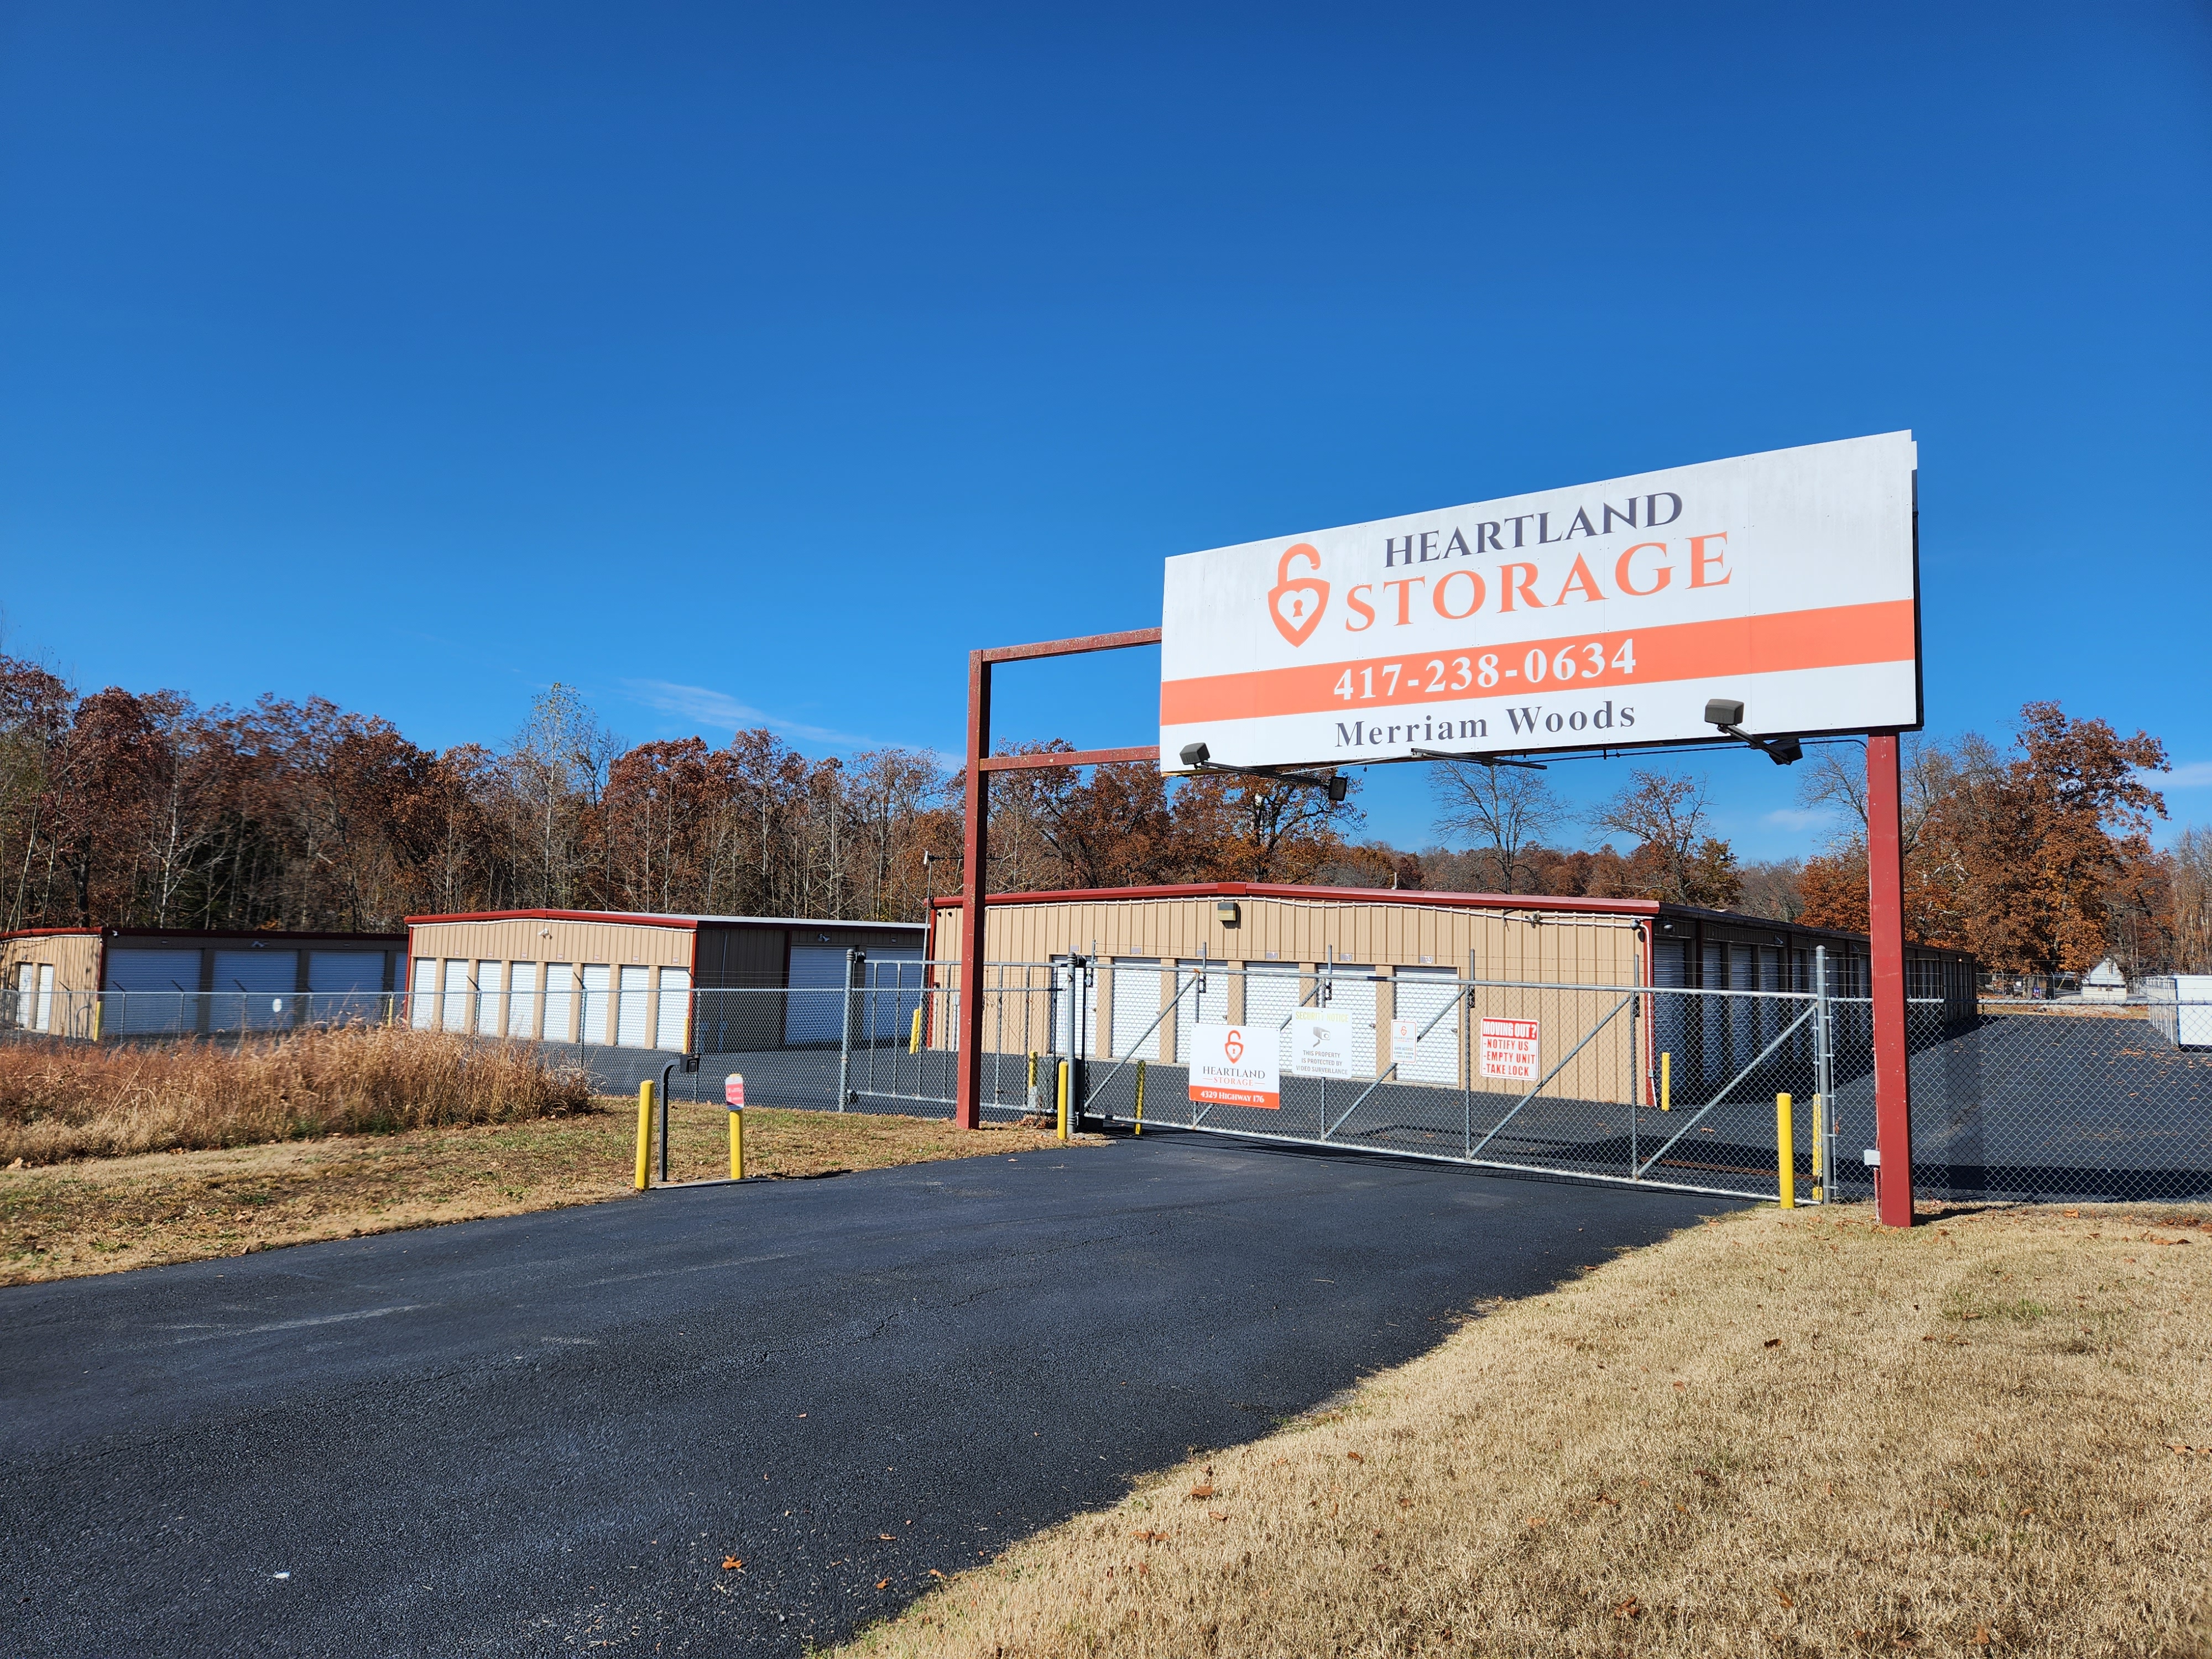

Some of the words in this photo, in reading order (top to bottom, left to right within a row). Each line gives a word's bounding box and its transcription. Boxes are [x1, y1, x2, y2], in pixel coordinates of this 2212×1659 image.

[1384, 492, 1682, 568] HEARTLAND
[1345, 531, 1733, 632] STORAGE
[1334, 638, 1636, 700] 417-238-0634
[1334, 715, 1488, 747] Merriam
[1505, 700, 1635, 735] Woods
[1295, 1011, 1324, 1021] SECURITY
[1327, 1013, 1349, 1022] NOTICE
[1483, 1021, 1514, 1037] MOVING
[1518, 1041, 1528, 1051] US
[1516, 1053, 1535, 1064] UNIT
[1203, 1066, 1265, 1079] HEARTLAND
[1312, 1066, 1348, 1074] SURVEILLANCE
[1508, 1065, 1529, 1076] LOCK
[1213, 1076, 1254, 1086] STORAGE
[1200, 1090, 1218, 1099] 4329
[1218, 1092, 1252, 1102] HIGHWAY
[1253, 1095, 1265, 1103] 176
